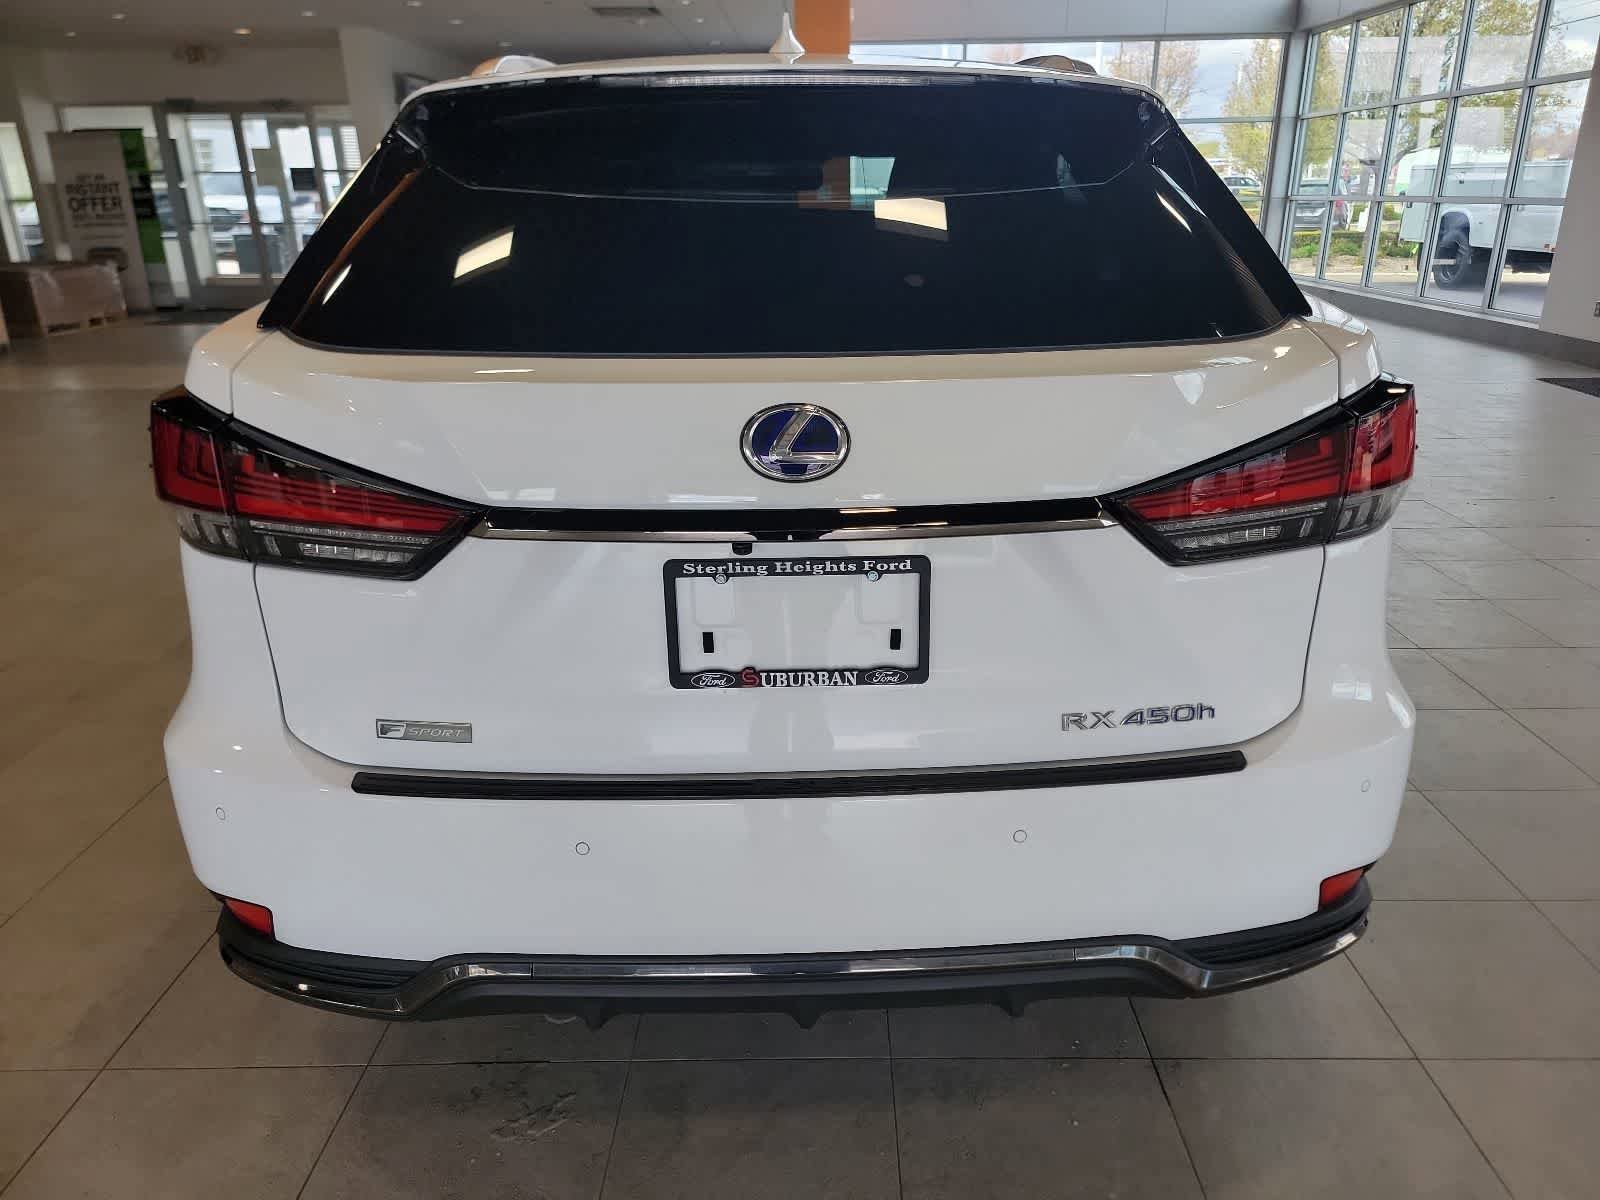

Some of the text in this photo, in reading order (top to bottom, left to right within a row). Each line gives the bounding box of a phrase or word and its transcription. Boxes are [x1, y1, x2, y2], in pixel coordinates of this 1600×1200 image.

[65, 183, 120, 195] INSTANT
[68, 196, 123, 212] OFFER
[683, 559, 912, 575] Sterling Heights Ford
[698, 673, 729, 687] Ford
[740, 668, 858, 687] SUBURBAN
[871, 670, 901, 684] Ford
[1061, 702, 1215, 731] RX 450h
[408, 727, 465, 737] SPORT
